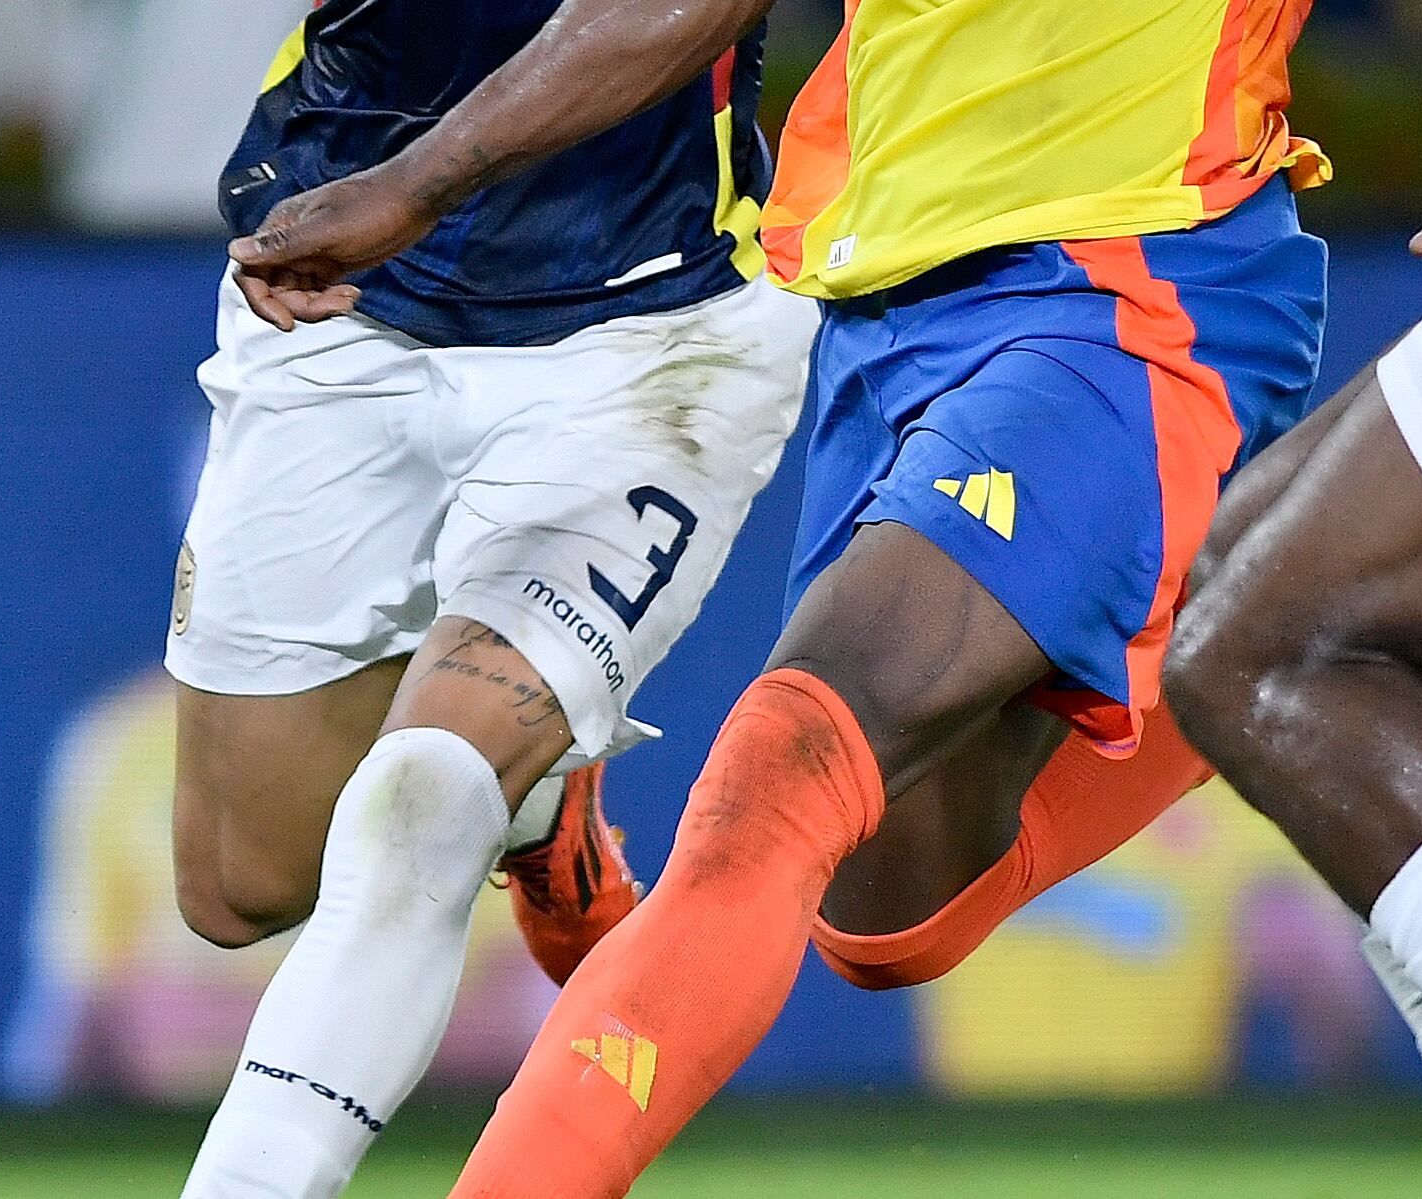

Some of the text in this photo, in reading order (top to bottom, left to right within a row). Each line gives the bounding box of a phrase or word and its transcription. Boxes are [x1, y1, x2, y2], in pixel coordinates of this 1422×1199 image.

[586, 485, 699, 635] 3
[521, 577, 625, 694] marathon
[244, 1059, 386, 1133] maratho
